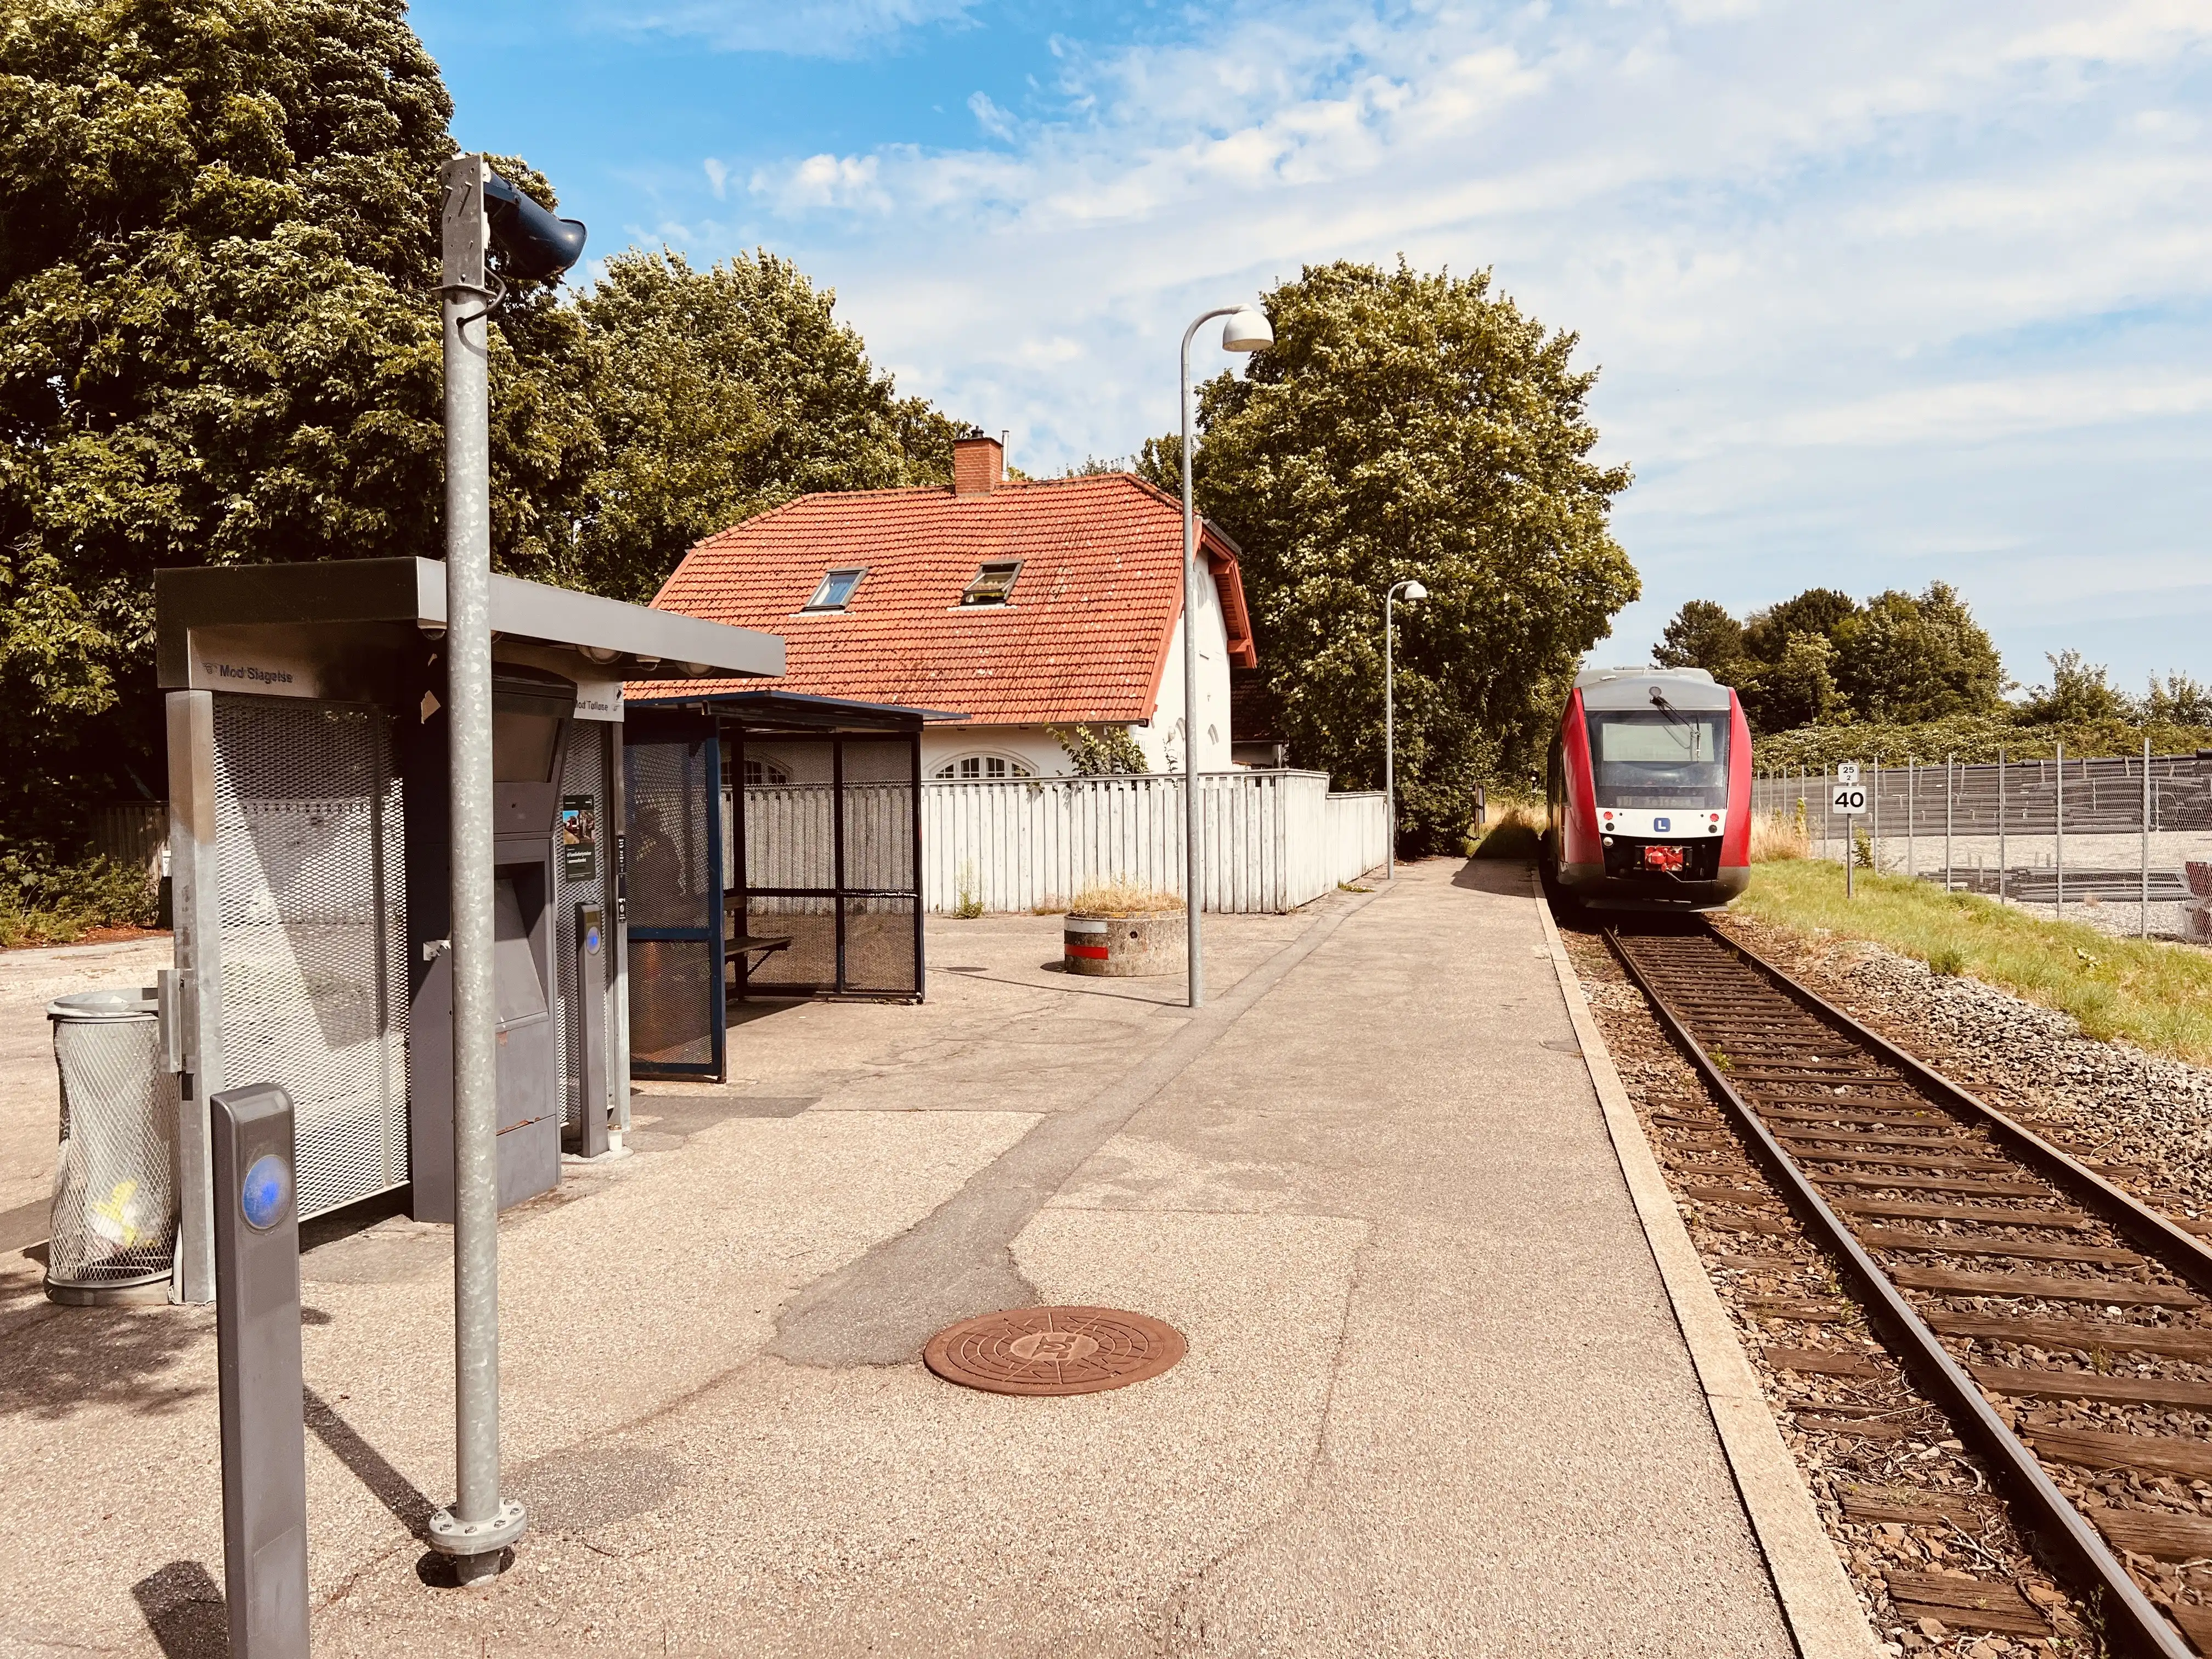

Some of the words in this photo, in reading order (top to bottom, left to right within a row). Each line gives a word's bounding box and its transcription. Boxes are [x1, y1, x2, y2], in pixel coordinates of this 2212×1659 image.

[220, 664, 244, 679] Mod
[247, 667, 293, 684] Slagelse
[1835, 792, 1864, 808] 40
[1658, 820, 1666, 830] L
